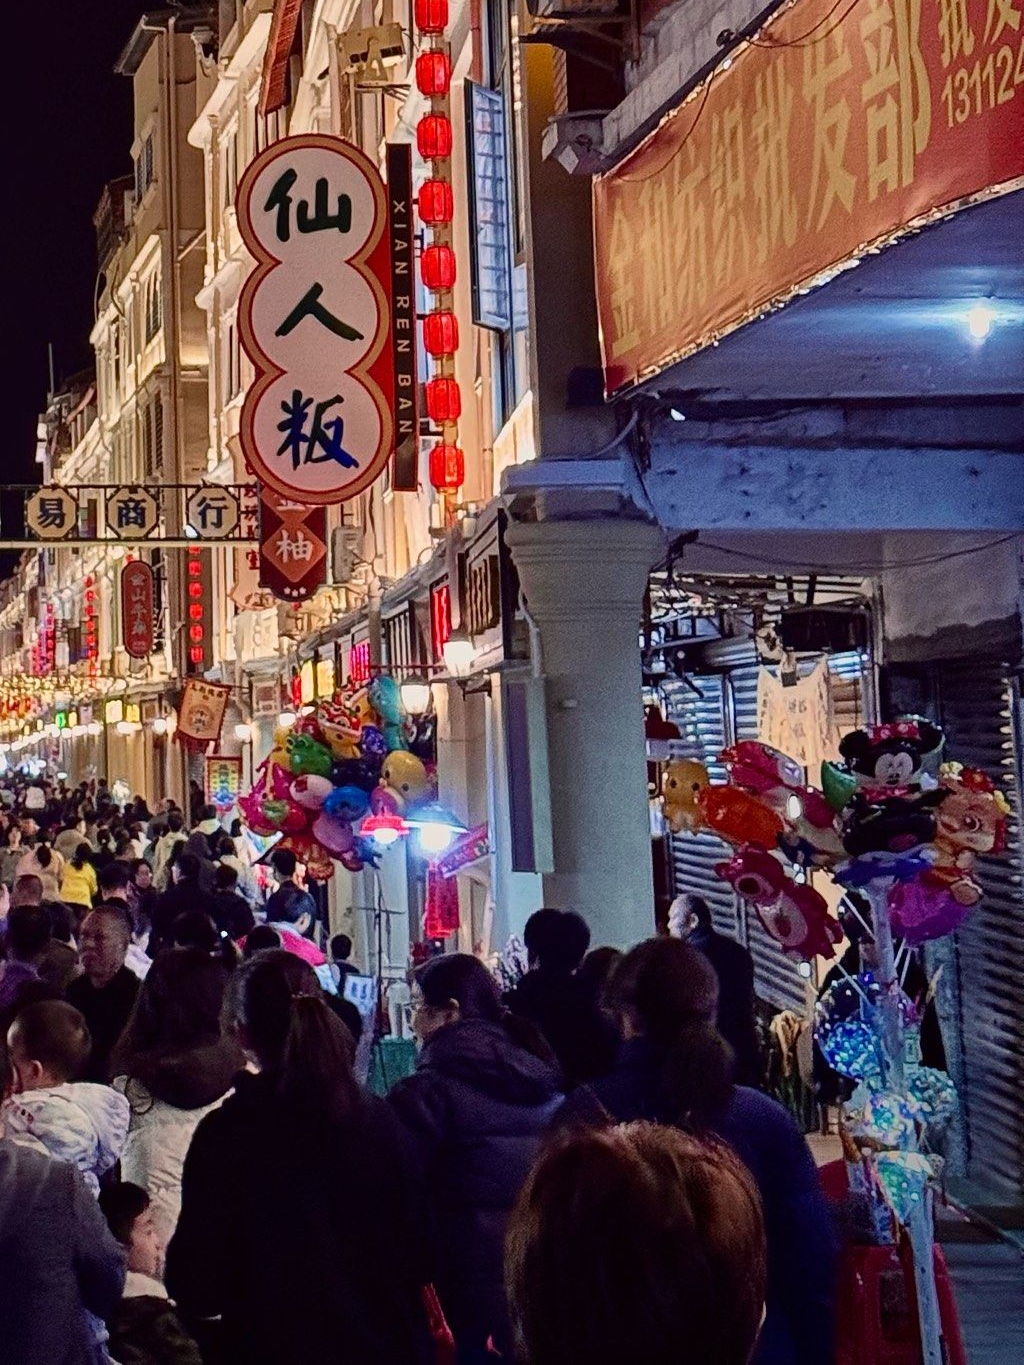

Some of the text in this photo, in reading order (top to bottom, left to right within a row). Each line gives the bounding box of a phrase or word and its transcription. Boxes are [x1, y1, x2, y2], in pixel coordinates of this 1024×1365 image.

[263, 167, 365, 471] 仙人粄
[392, 199, 413, 434] XIAN REN BAN
